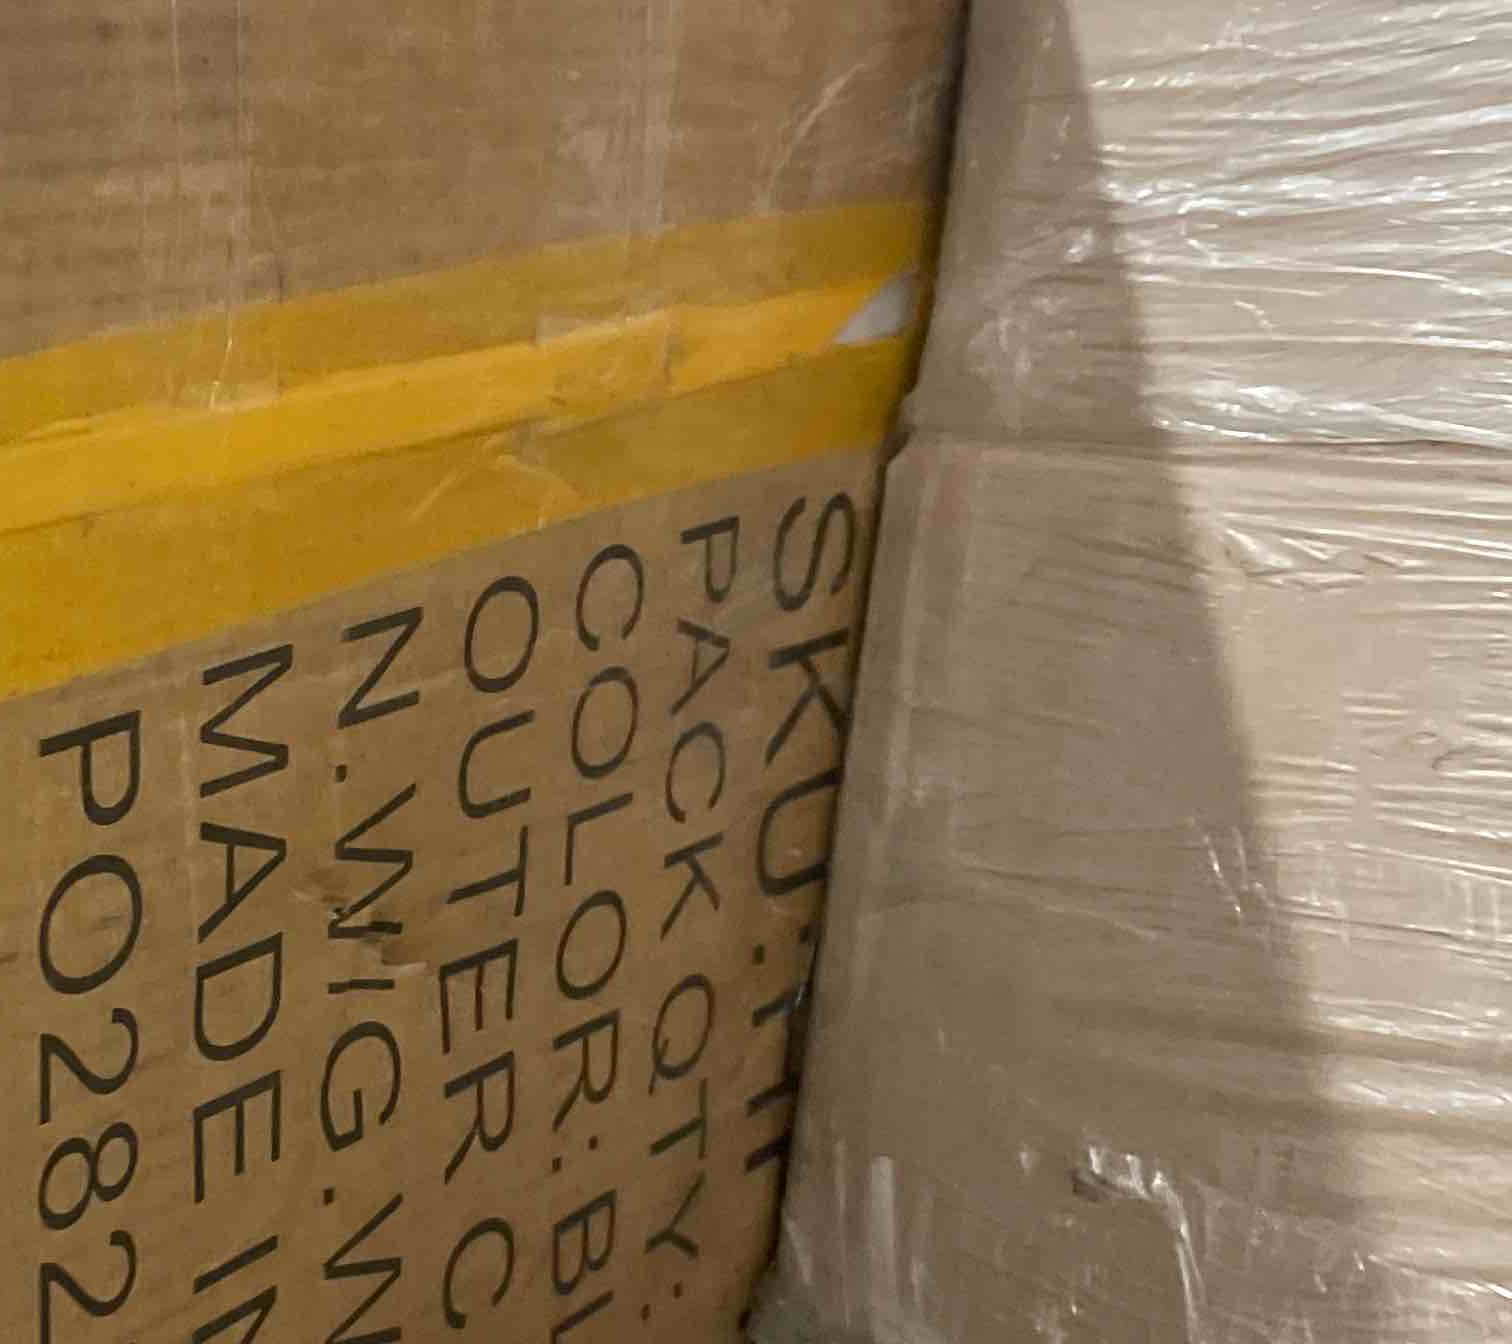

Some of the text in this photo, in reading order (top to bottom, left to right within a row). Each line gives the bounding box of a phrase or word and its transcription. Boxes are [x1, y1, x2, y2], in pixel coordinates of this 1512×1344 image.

[192, 643, 292, 1205] MADE
[439, 576, 539, 1184] OUTER
[551, 543, 644, 1174] COLOR:
[661, 516, 740, 942] PACK
[644, 974, 716, 1320] QTY:
